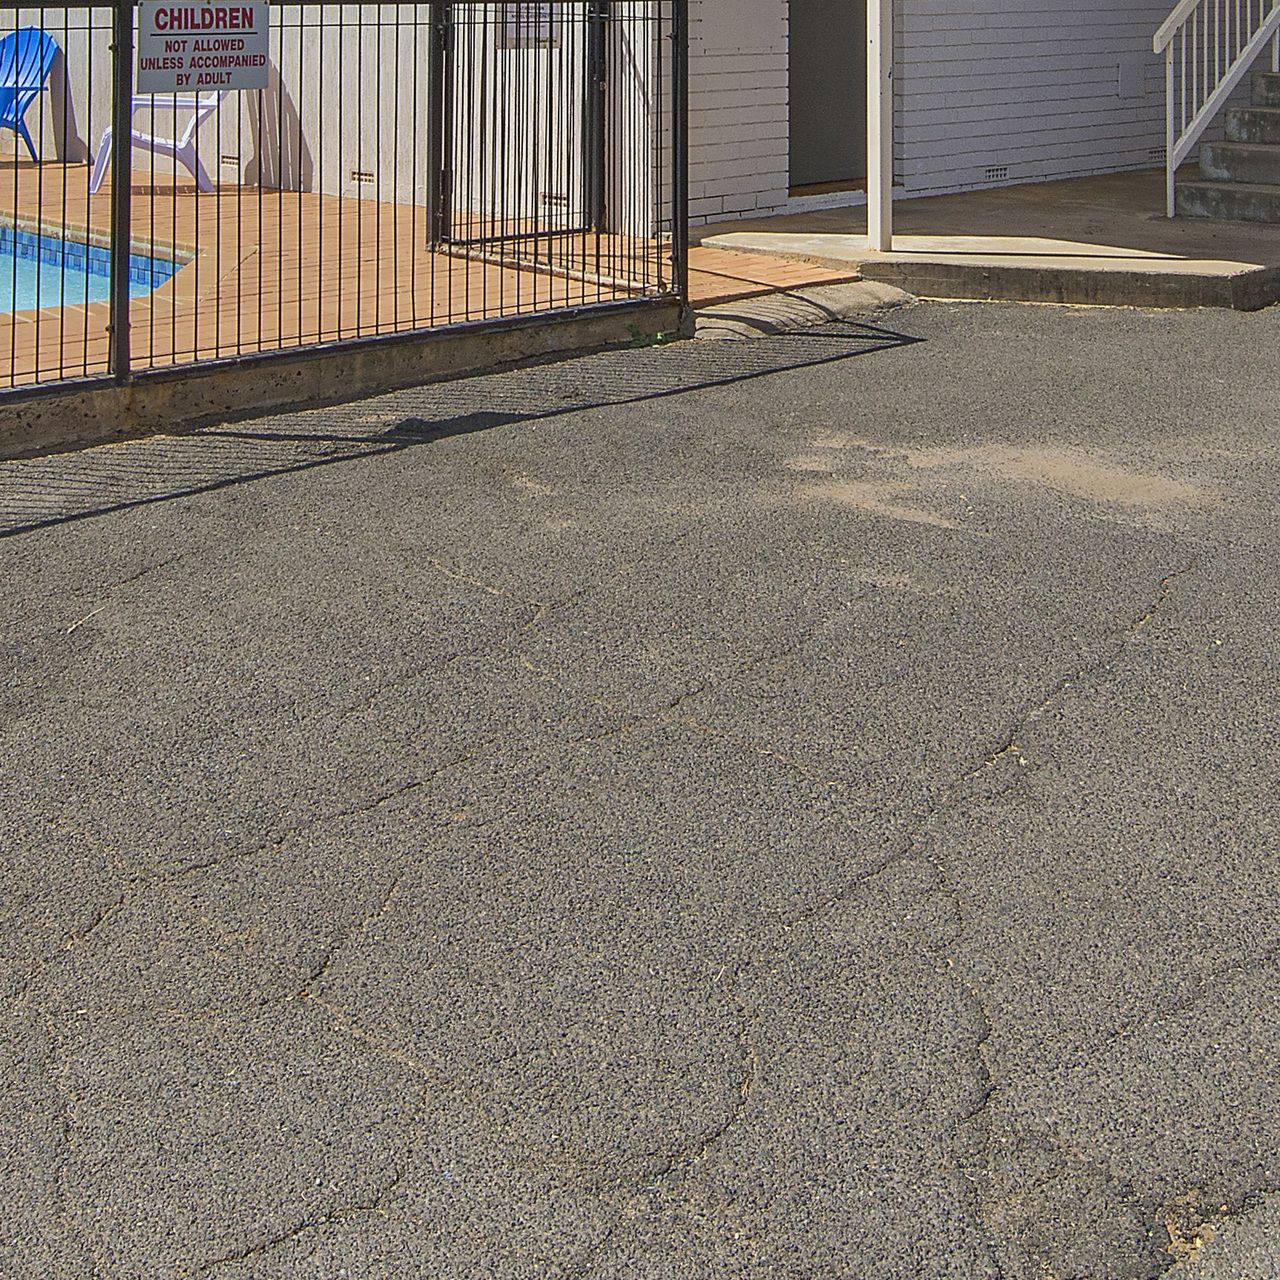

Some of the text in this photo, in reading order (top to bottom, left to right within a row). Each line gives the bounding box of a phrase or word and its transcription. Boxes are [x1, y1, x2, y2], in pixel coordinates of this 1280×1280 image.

[154, 7, 254, 30] CHILDREN
[165, 39, 245, 53] NOT ALLOWED
[140, 54, 266, 71] UNLESS ACCOMPANIED
[176, 72, 232, 86] BY ADULT
